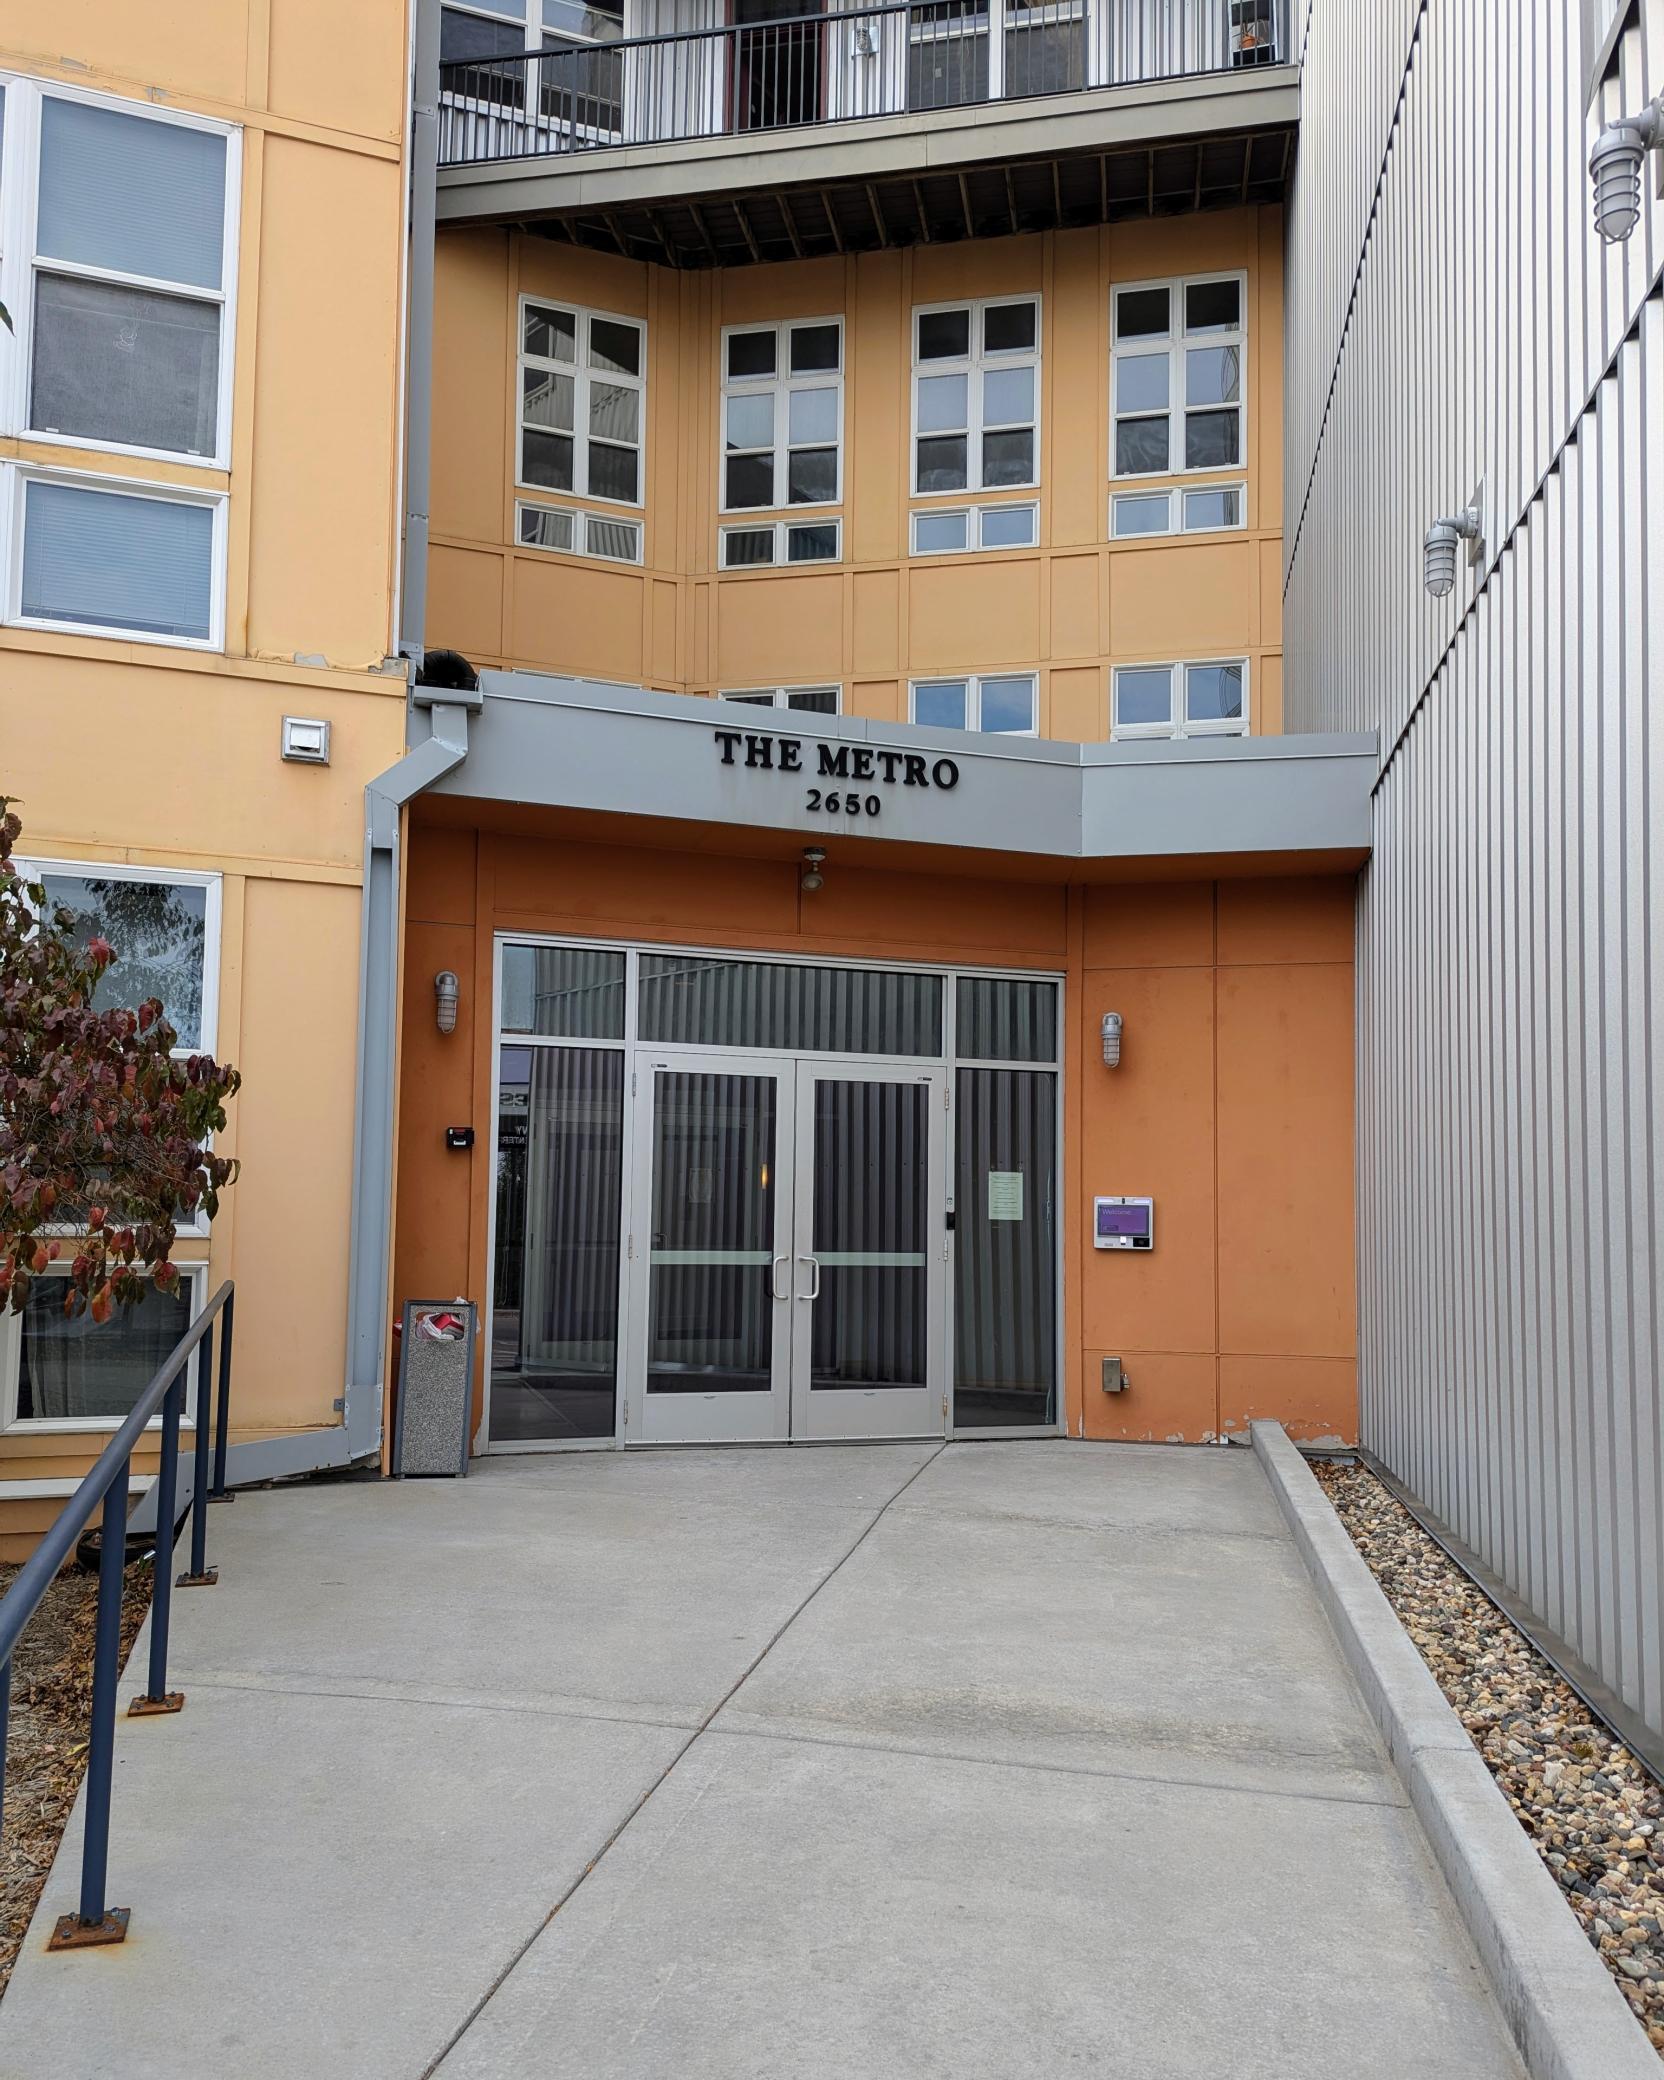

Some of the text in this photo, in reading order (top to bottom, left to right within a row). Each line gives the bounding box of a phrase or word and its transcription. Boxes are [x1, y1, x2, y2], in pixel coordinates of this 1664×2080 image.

[715, 731, 959, 789] THE METRO
[806, 789, 881, 816] 2650
